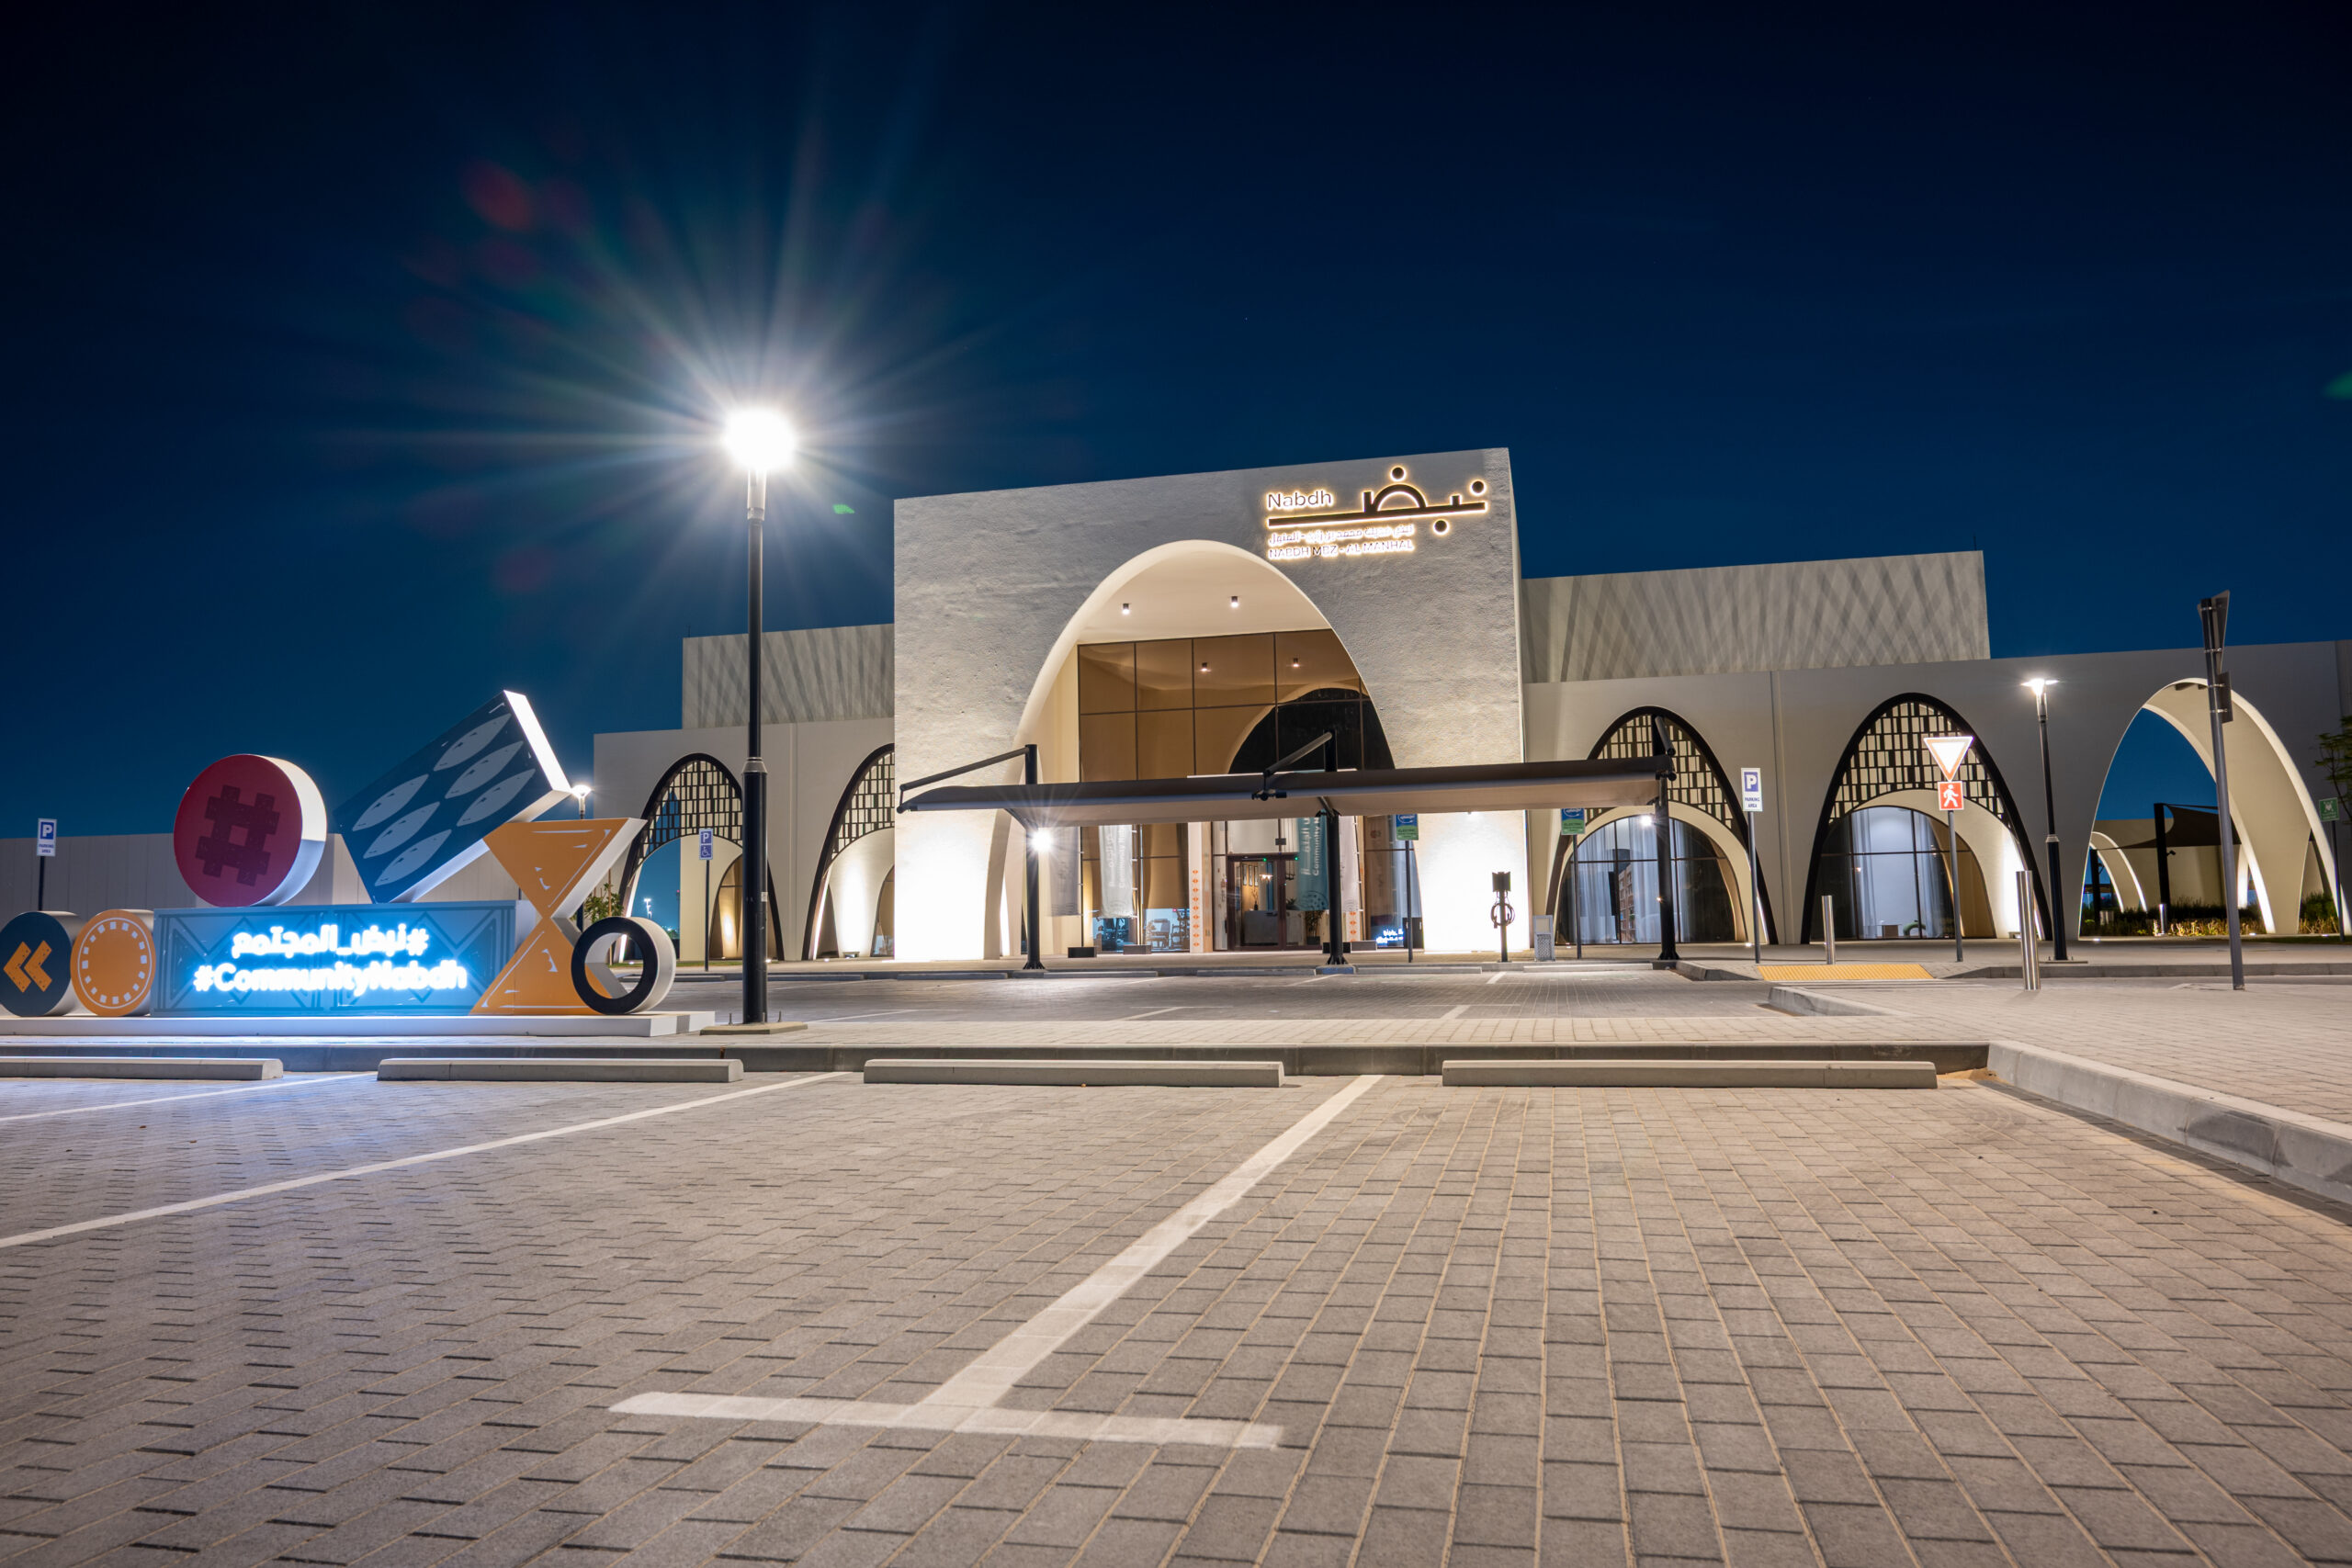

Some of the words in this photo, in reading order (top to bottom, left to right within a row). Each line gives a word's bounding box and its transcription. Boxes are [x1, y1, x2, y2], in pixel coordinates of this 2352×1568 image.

[1267, 491, 1332, 509] Nabdh
[1268, 547, 1311, 559] NABDH
[1313, 545, 1339, 557] MBZ
[1346, 544, 1363, 555] AL
[1363, 539, 1415, 554] MANHAL
[194, 960, 468, 997] #CommunityNabdh
